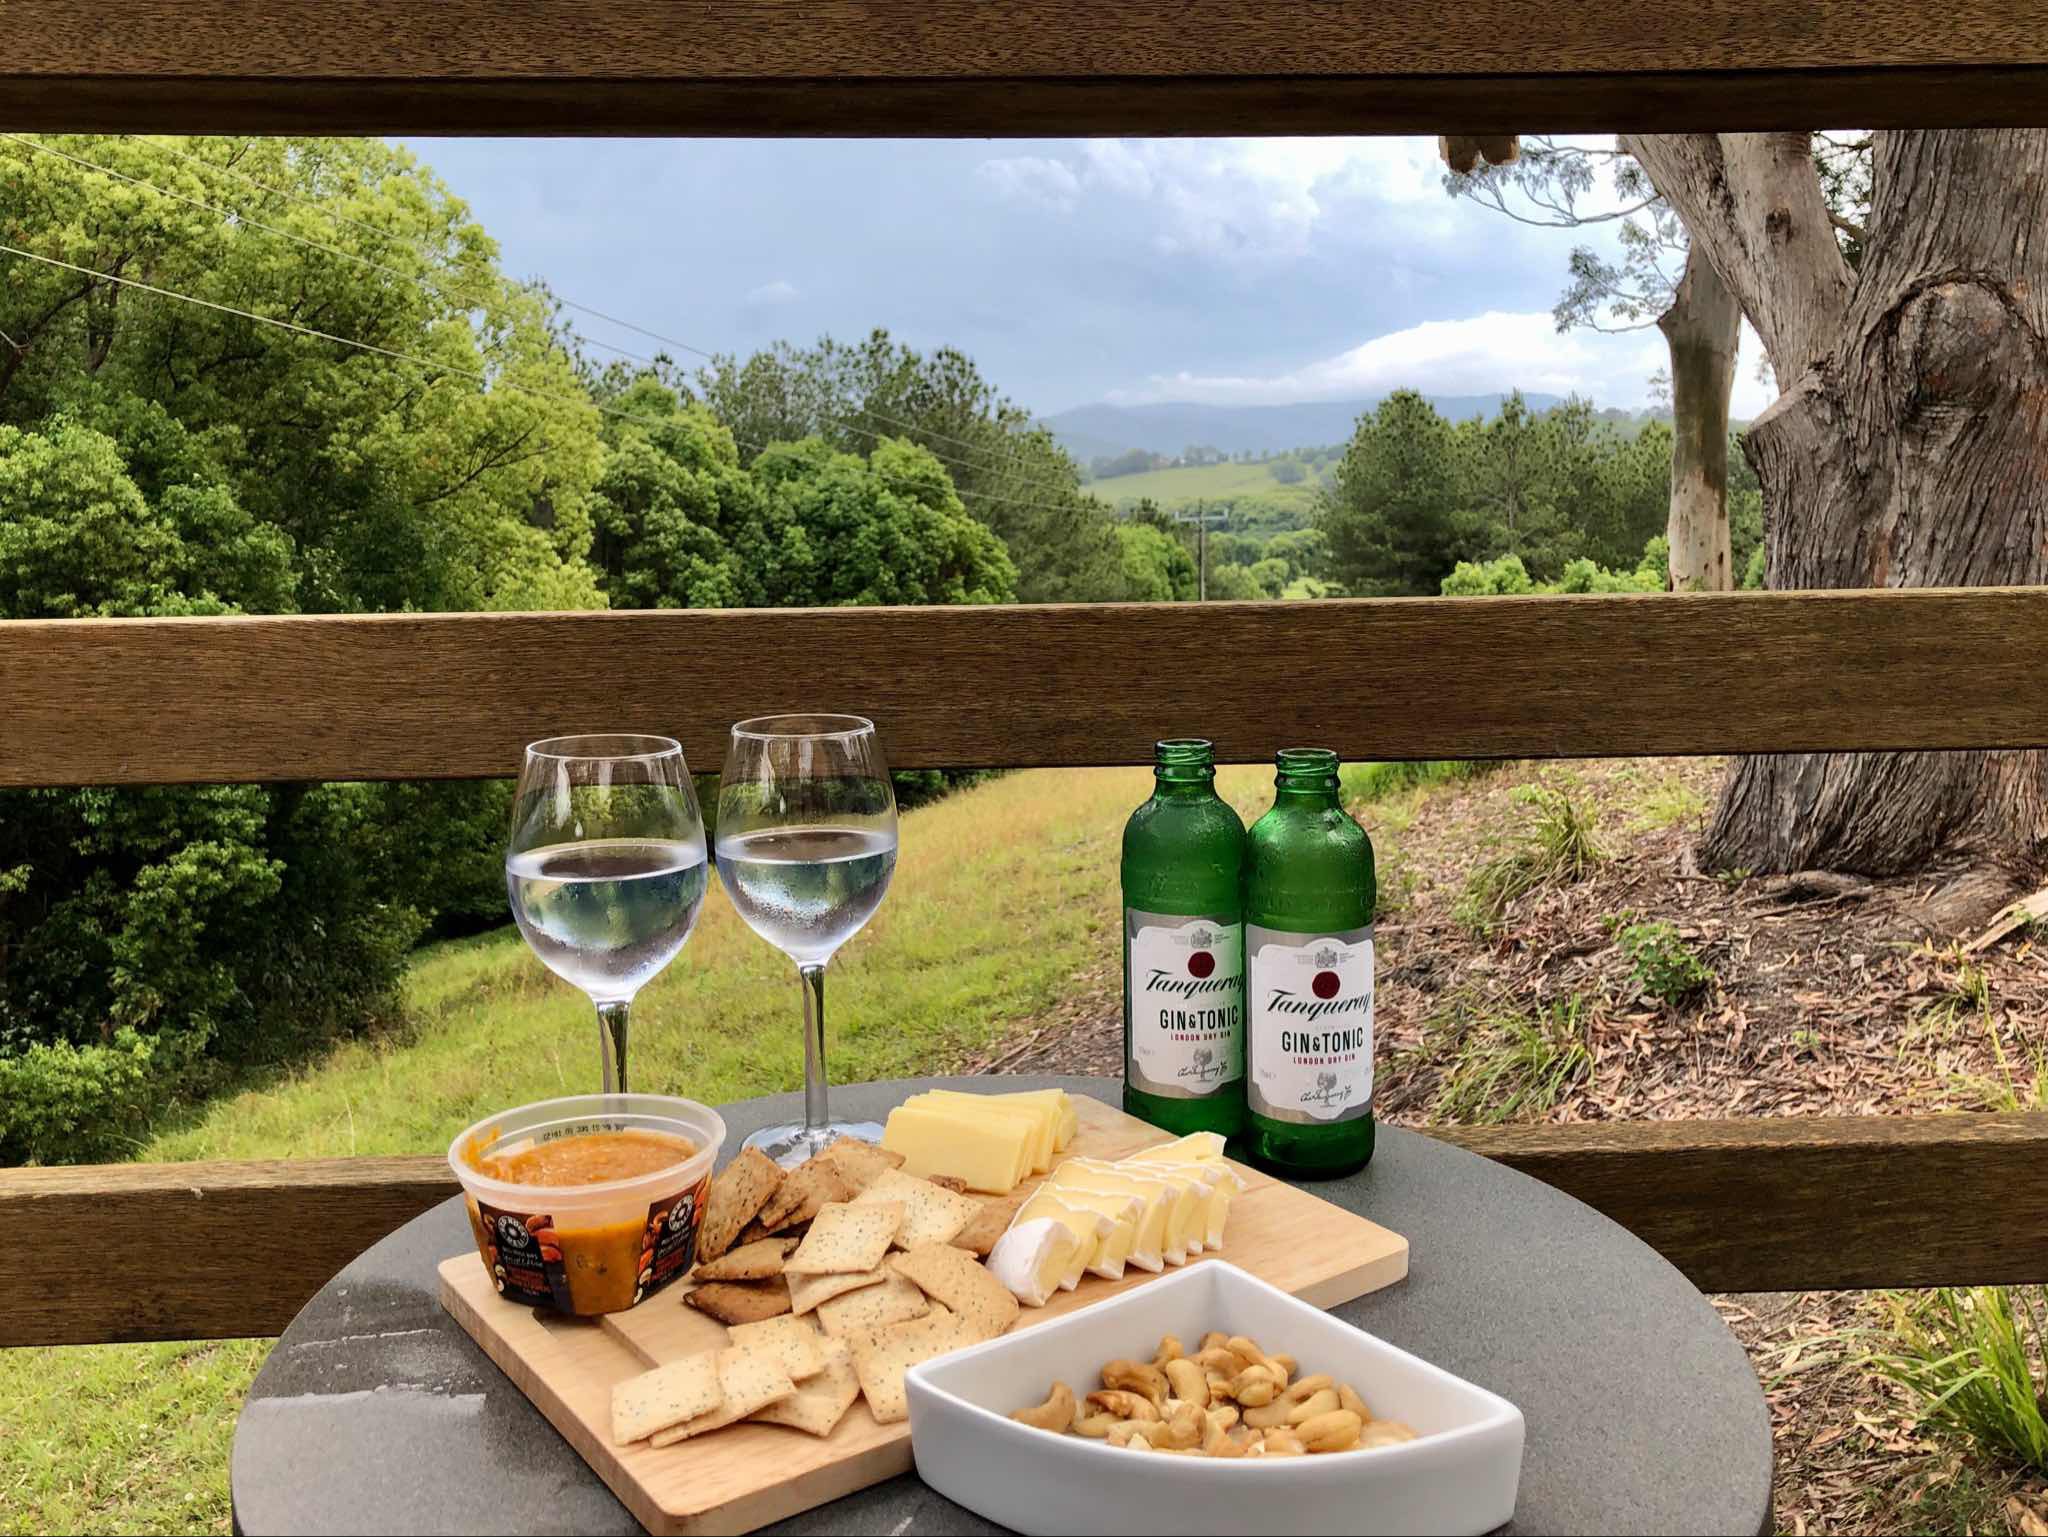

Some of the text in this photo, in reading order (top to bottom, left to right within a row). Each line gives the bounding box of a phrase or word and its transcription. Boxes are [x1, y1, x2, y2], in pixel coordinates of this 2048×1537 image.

[1146, 969, 1243, 999] Tanqueray
[1267, 989, 1371, 1021] Tanqueray
[1170, 1032, 1200, 1041] LONDON
[1204, 1032, 1216, 1041] DRY
[1293, 1056, 1325, 1065] LONDON
[1328, 1056, 1341, 1065] DRY
